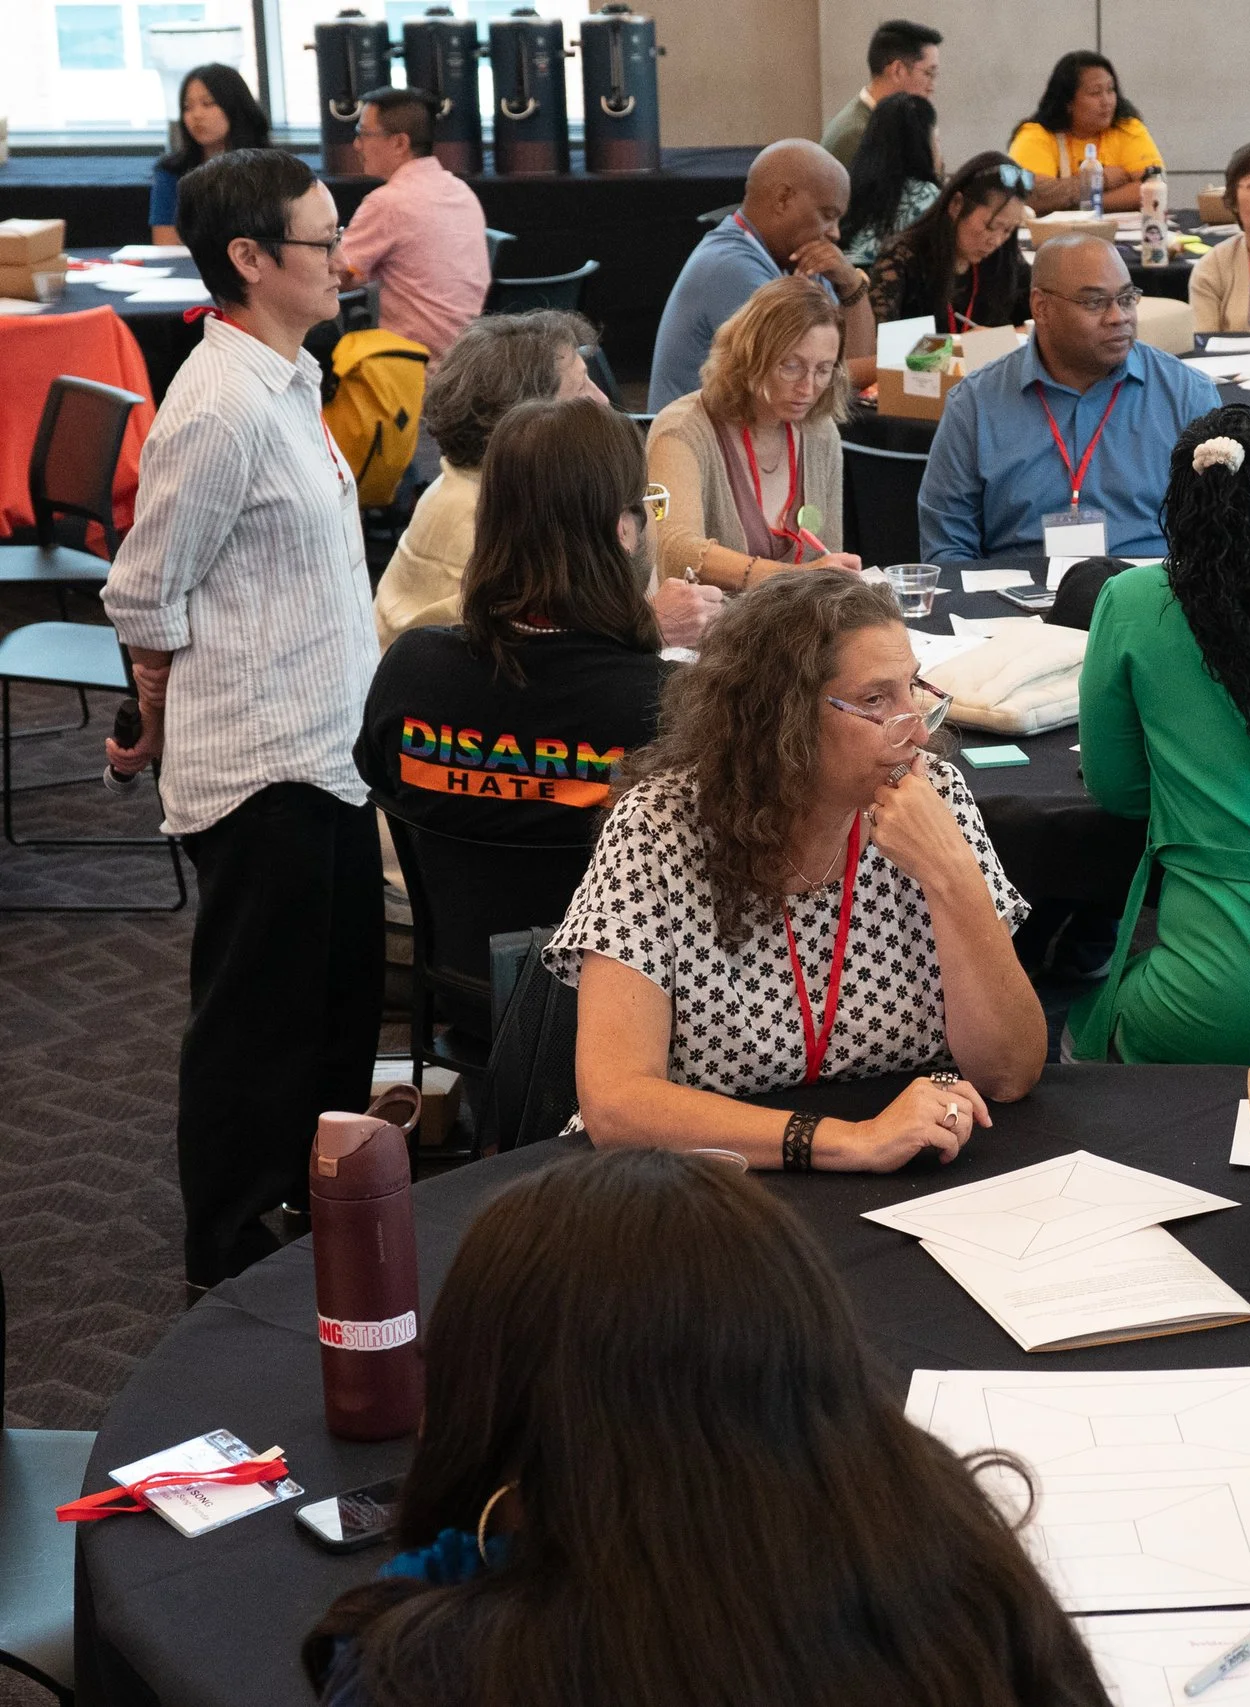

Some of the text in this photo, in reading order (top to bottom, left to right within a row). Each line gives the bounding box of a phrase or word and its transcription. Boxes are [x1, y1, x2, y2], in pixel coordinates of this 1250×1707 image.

[401, 716, 624, 780] DISARM
[447, 771, 556, 800] HATE
[190, 1489, 214, 1508] SONG
